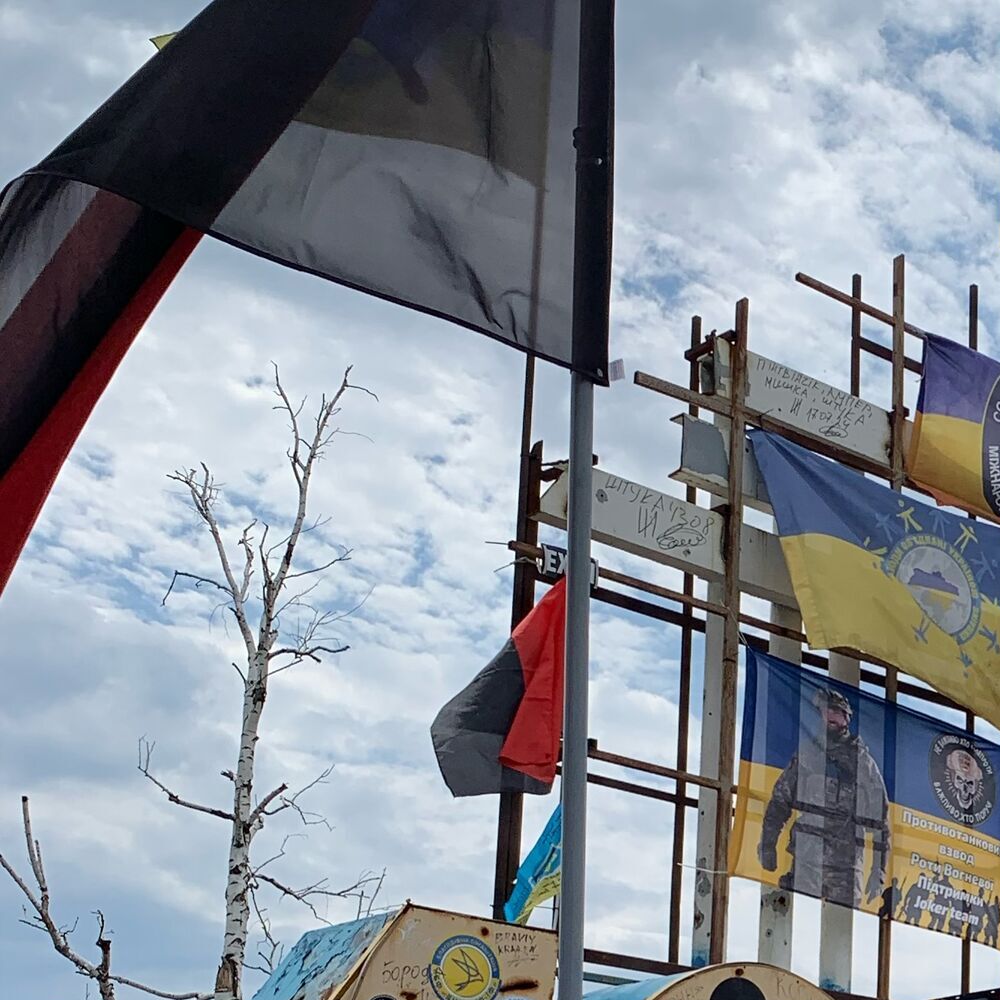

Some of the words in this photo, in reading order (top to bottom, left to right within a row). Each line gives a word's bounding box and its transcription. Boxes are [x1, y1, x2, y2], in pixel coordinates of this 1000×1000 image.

[938, 844, 976, 866] взвод
[910, 851, 942, 874] Роти
[943, 863, 995, 891] Вогневої
[914, 895, 949, 916] Joker
[950, 904, 980, 926] team
